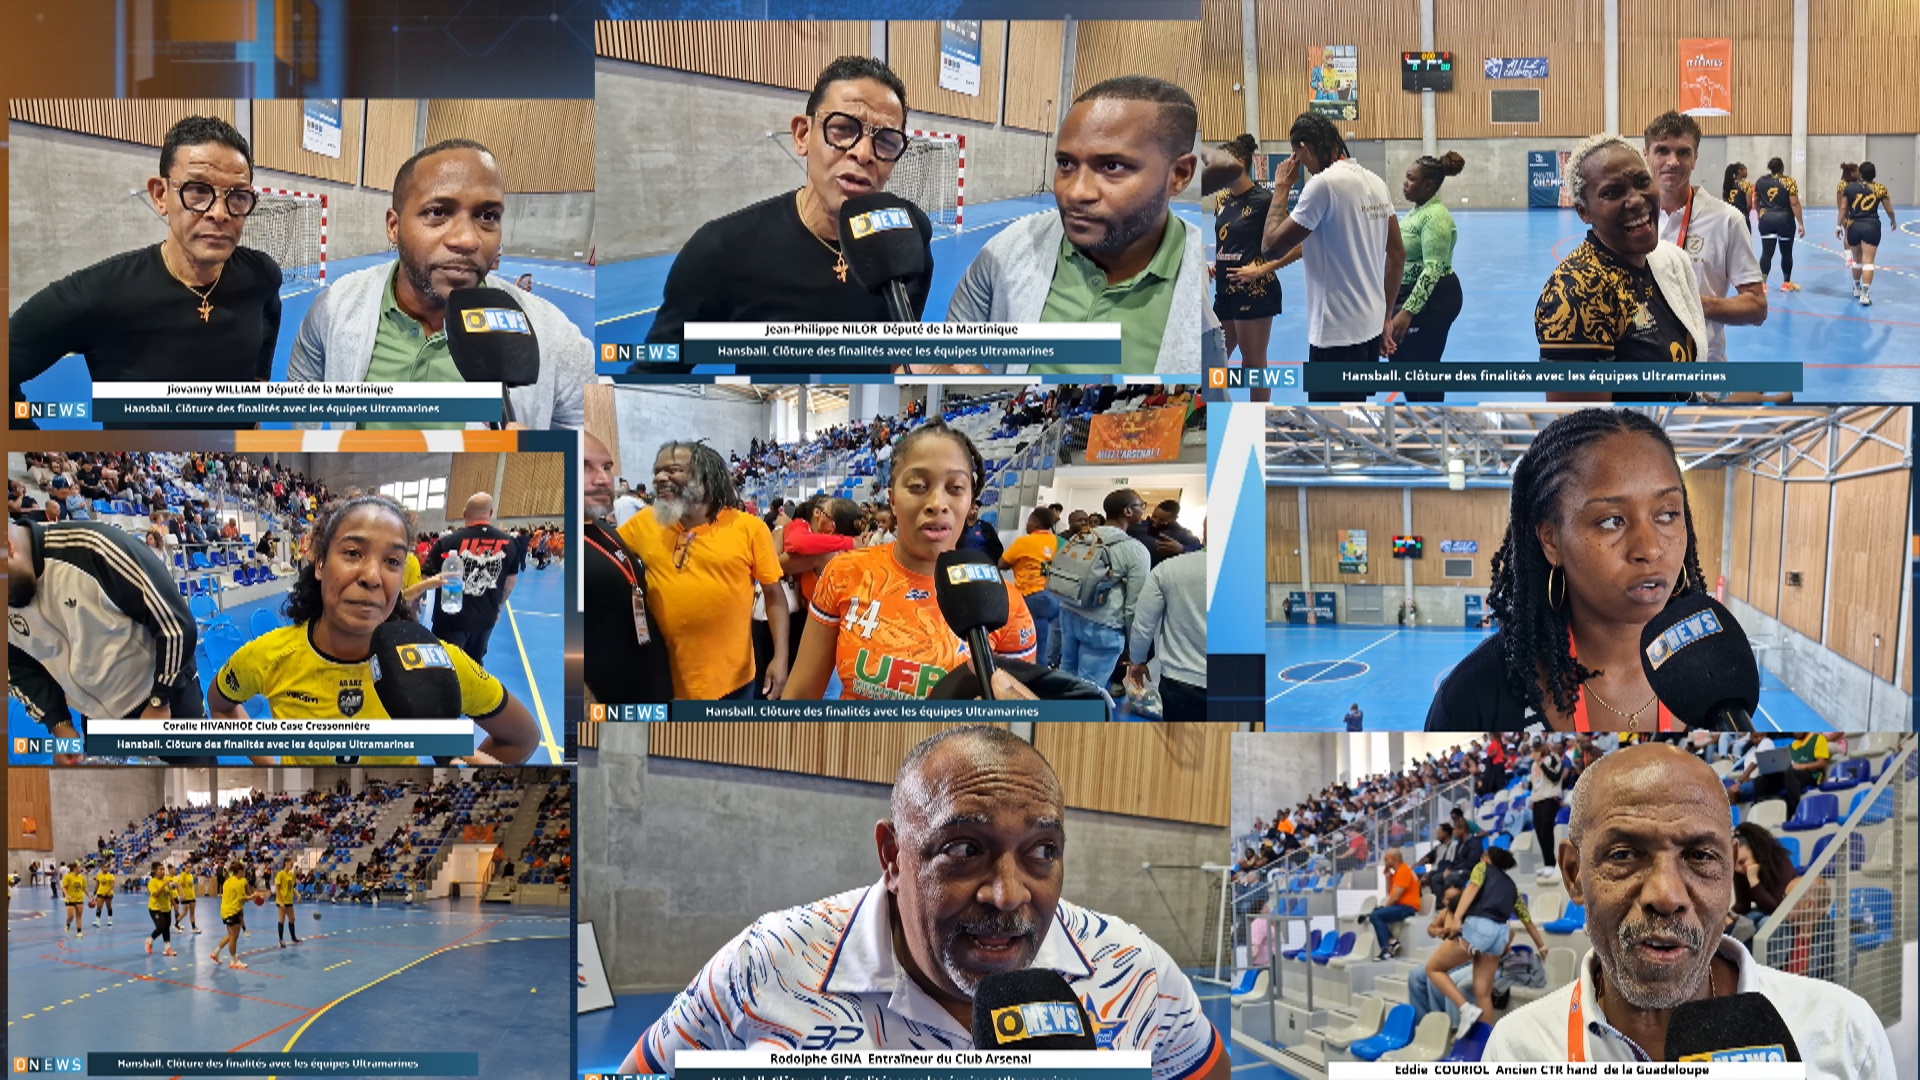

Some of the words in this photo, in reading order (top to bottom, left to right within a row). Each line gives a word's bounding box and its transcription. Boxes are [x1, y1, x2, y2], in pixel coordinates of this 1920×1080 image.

[1766, 187, 1779, 202] 9
[1851, 193, 1877, 212] 10
[844, 596, 882, 639] 44
